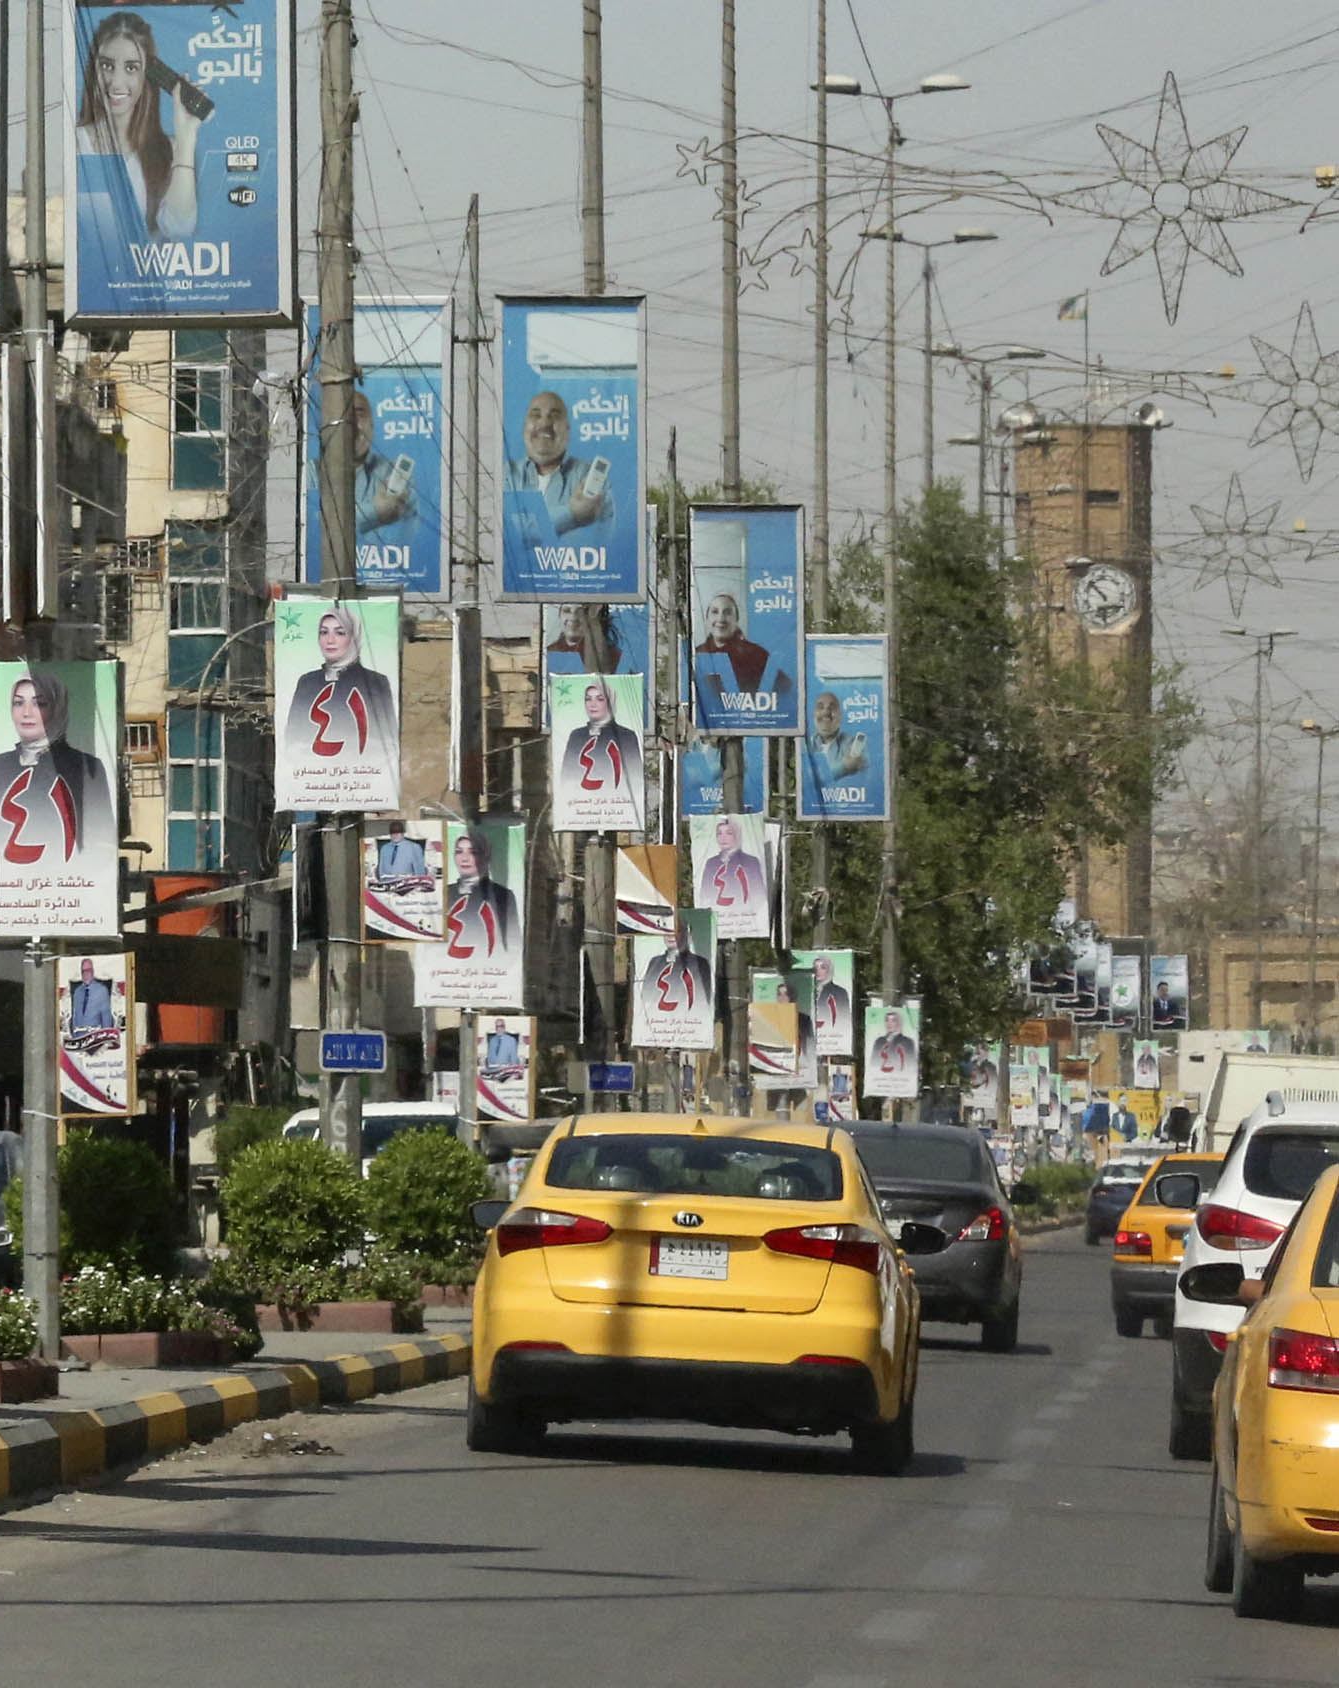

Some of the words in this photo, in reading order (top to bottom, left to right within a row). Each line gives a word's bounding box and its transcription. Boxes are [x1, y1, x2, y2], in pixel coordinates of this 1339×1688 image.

[196, 53, 262, 84] بالجو
[225, 136, 259, 149] QLED
[129, 241, 230, 277] WADI
[383, 417, 434, 441] بالجو
[579, 418, 629, 443] بالجو
[534, 546, 606, 571] WADI
[720, 692, 777, 711] WADI
[308, 681, 368, 757] ٤١
[579, 736, 622, 790] ٤١
[822, 787, 865, 802] WADI
[0, 766, 78, 865] ٤١
[713, 863, 749, 906] ٤١
[447, 895, 498, 960] ٤١
[656, 961, 694, 1013] ٤١
[677, 1212, 699, 1225] KIA
